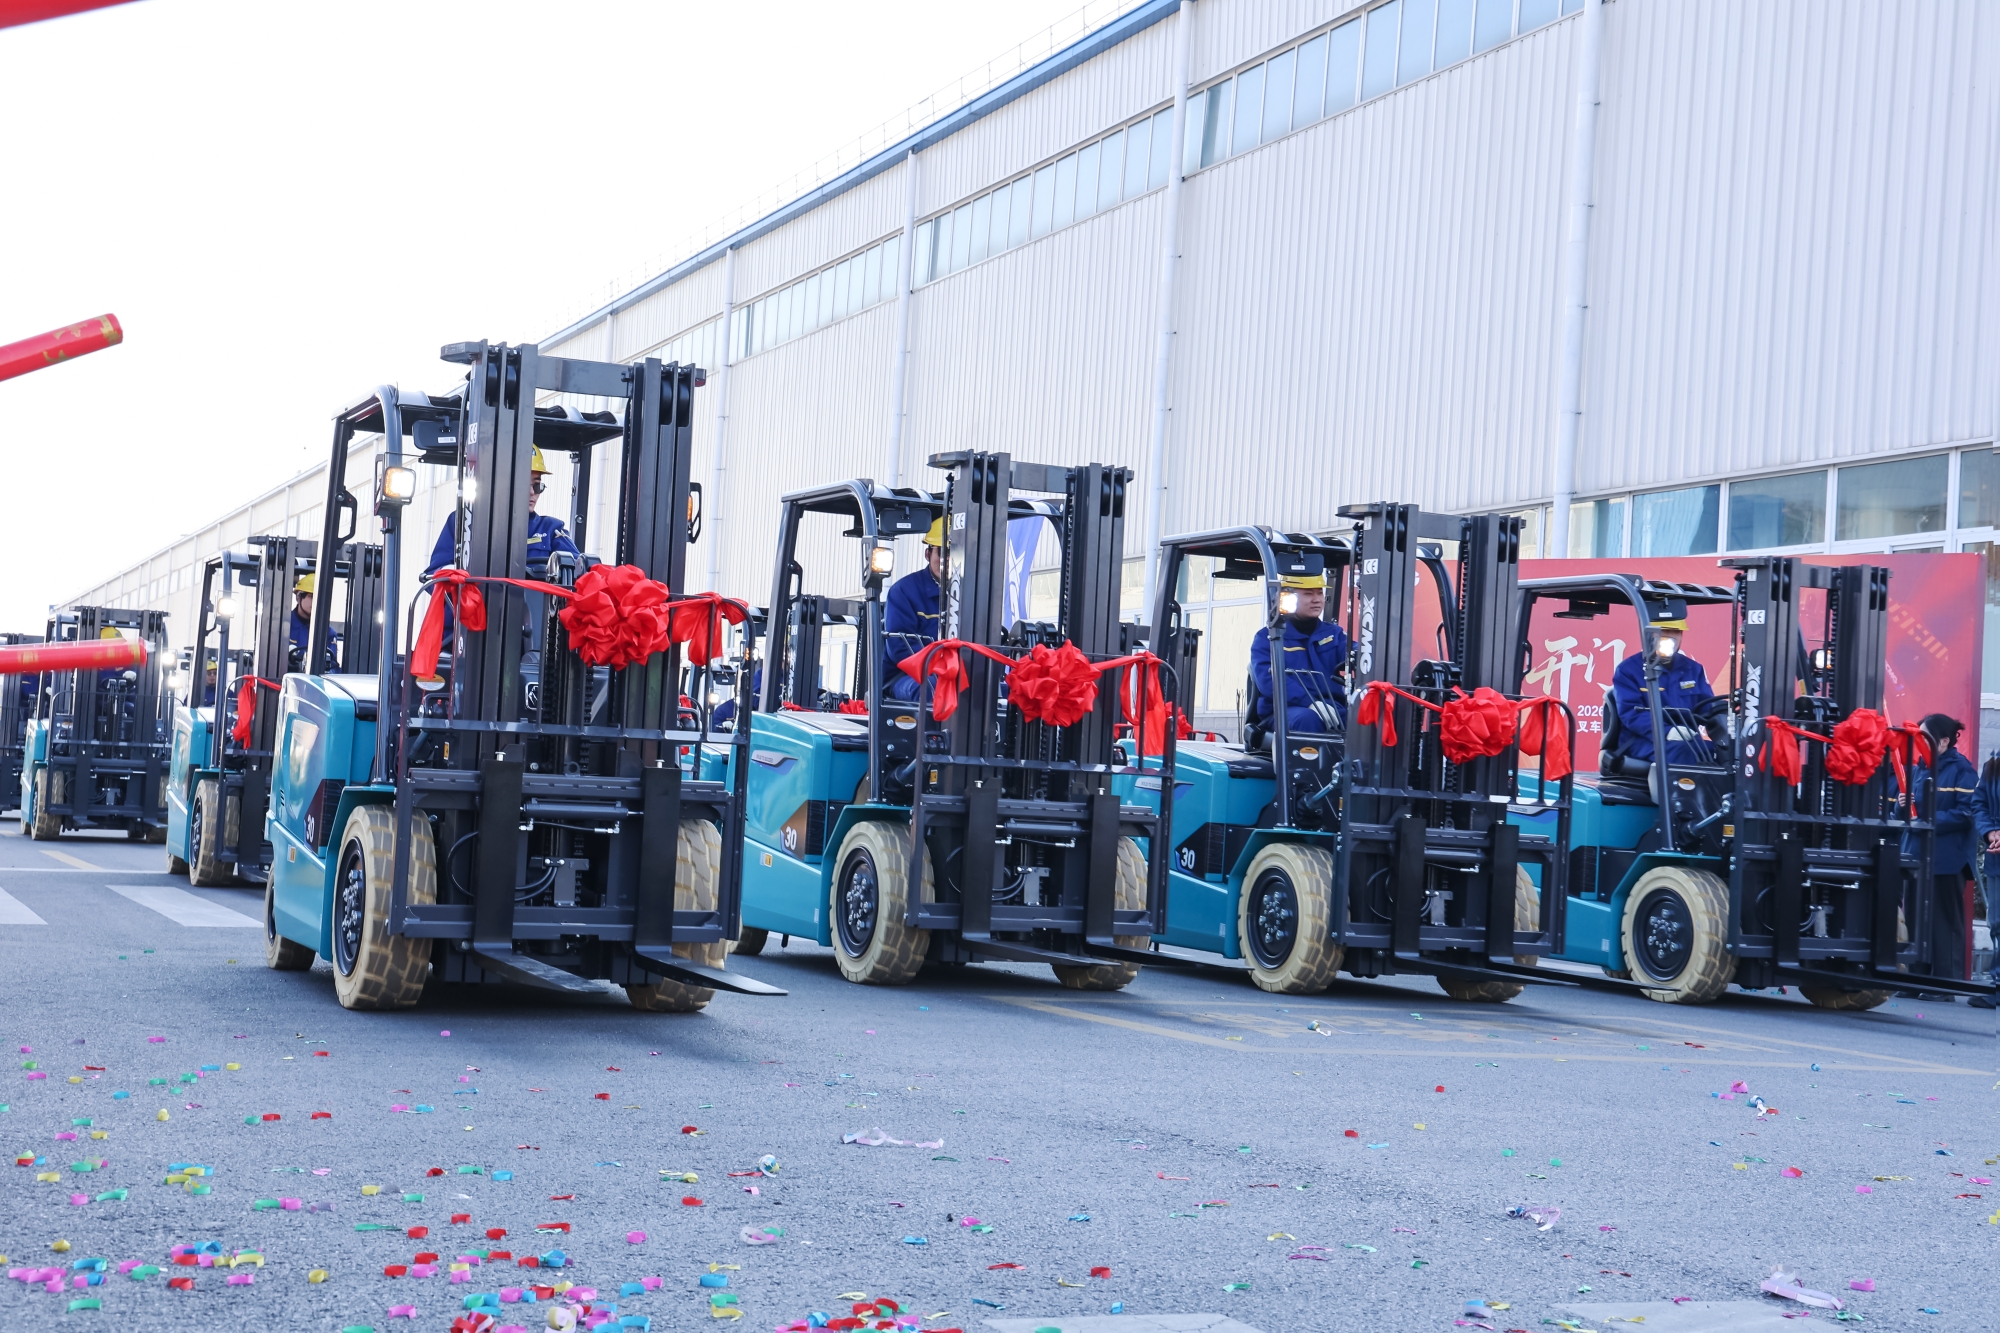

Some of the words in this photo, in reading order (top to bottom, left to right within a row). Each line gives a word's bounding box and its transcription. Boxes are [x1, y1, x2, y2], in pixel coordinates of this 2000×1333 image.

[954, 514, 964, 529] CE
[1365, 560, 1377, 573] CE
[1750, 611, 1763, 623] CE
[1360, 594, 1375, 675] XCMG
[1744, 662, 1761, 737] XCMG
[1577, 704, 1604, 717] 2026
[1577, 720, 1602, 733] 叉车
[306, 814, 315, 843] 30
[784, 826, 797, 850] 30
[1181, 847, 1195, 869] 30
